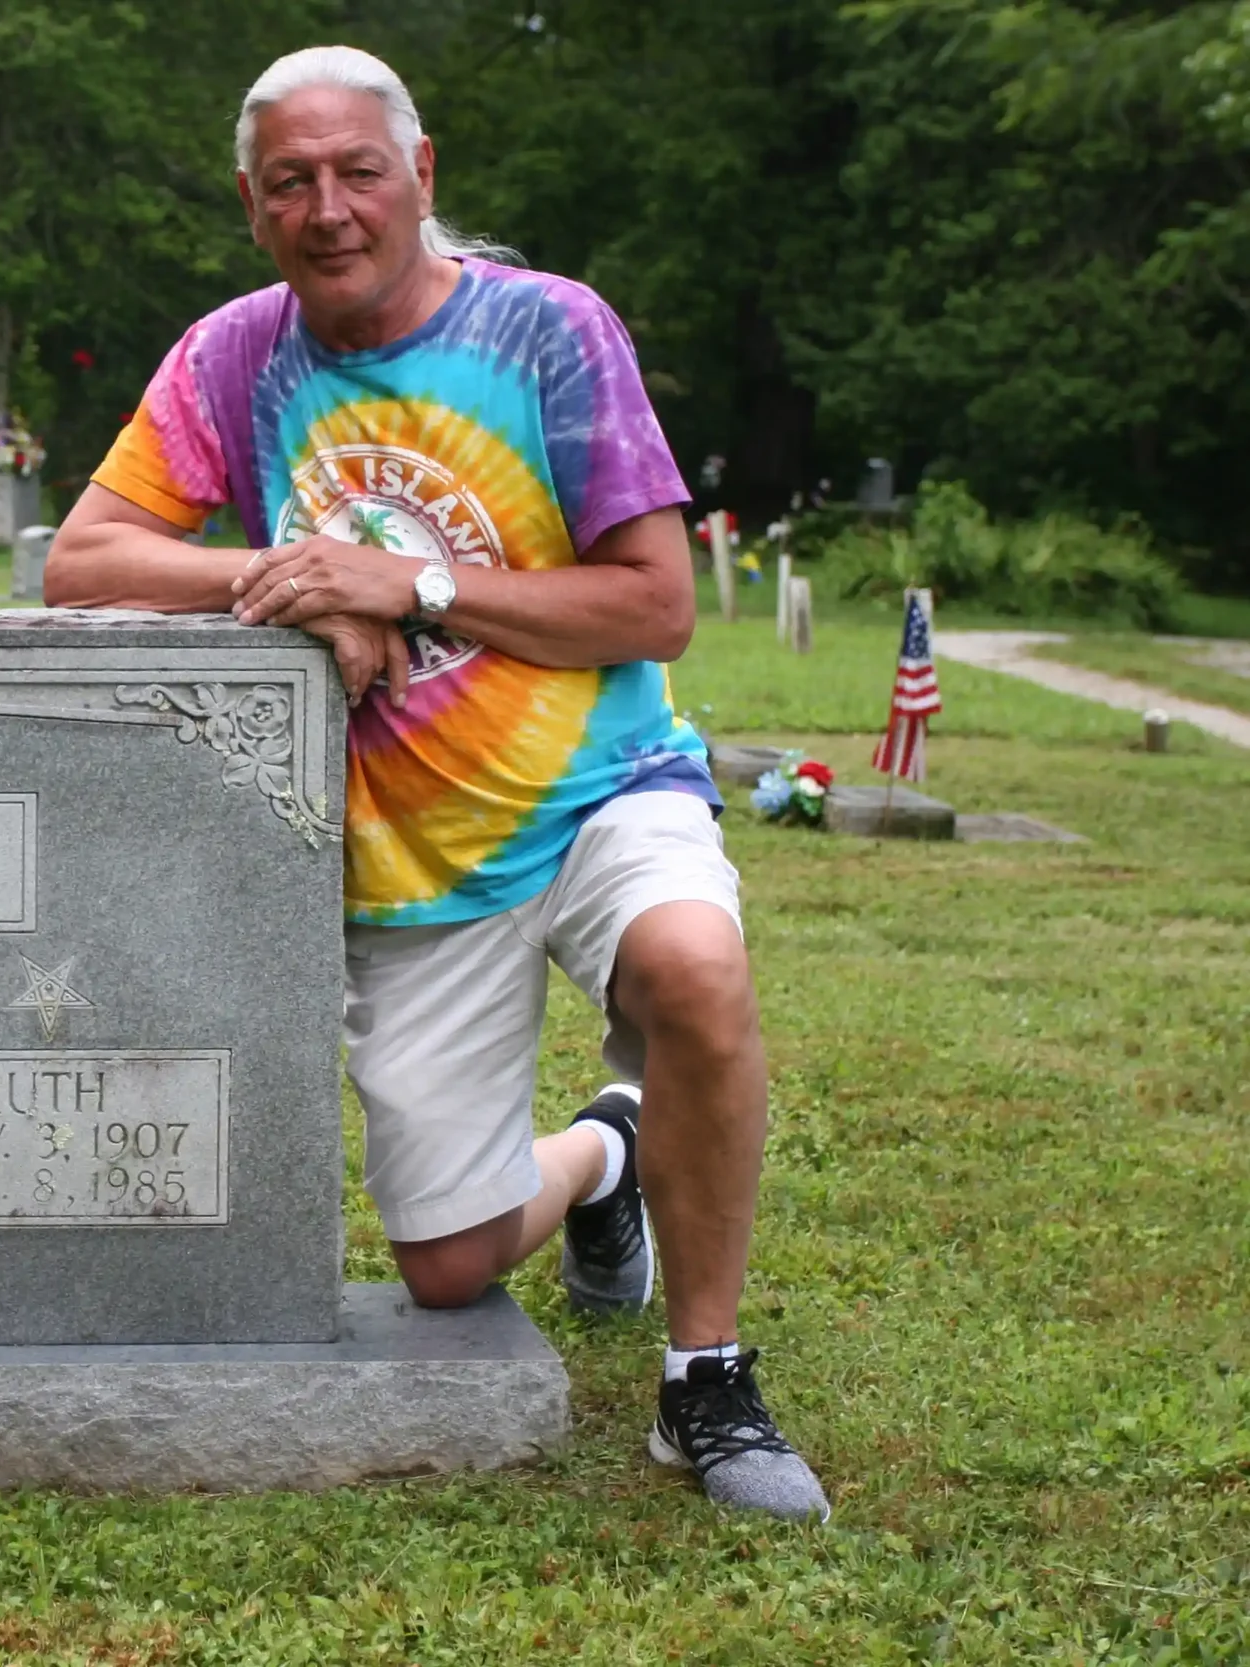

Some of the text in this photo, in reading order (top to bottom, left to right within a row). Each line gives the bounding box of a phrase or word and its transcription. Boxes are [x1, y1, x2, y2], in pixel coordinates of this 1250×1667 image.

[91, 1123, 190, 1161] 1907
[33, 1168, 75, 1206] 8,
[91, 1168, 187, 1205] 1985
